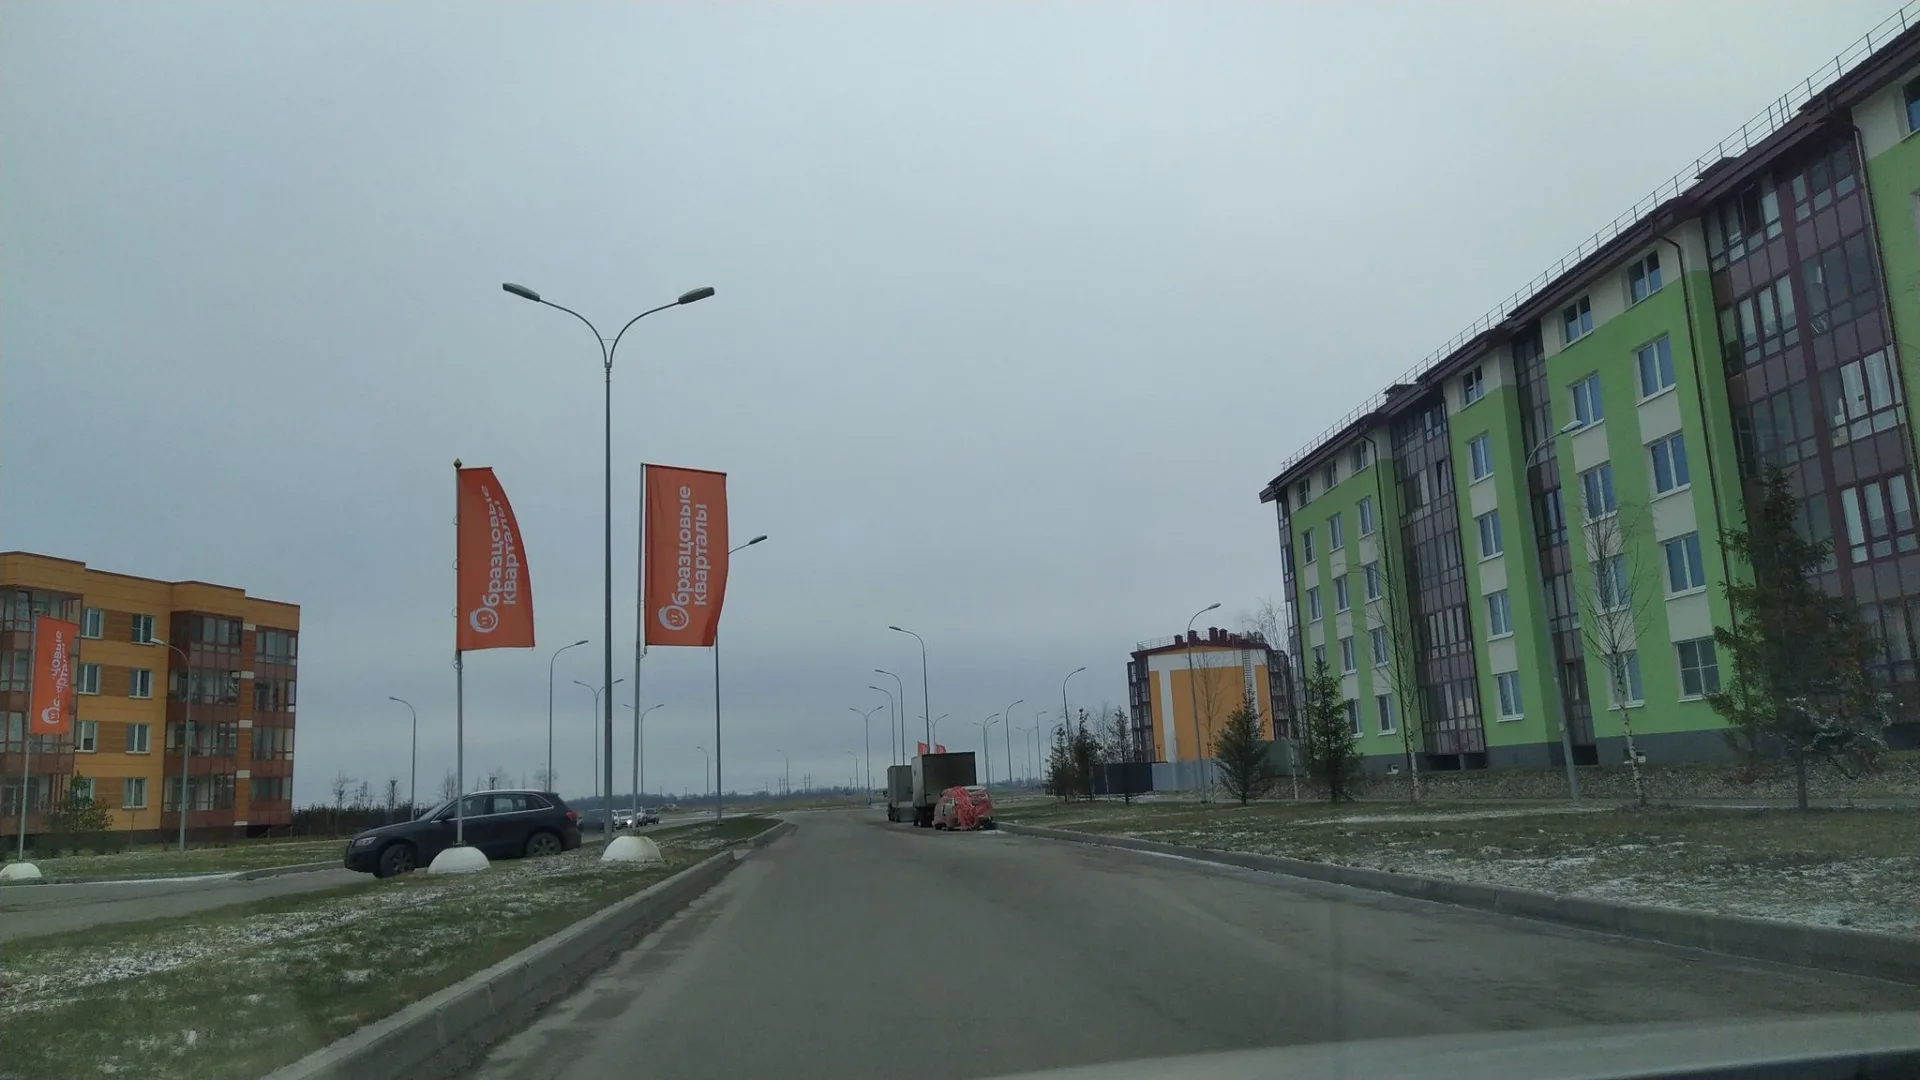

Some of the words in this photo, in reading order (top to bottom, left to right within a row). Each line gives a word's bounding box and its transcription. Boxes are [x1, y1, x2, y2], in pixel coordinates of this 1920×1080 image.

[469, 485, 504, 633] Образцовые
[494, 500, 520, 605] кварталы
[658, 485, 694, 631] Образцовые
[694, 503, 711, 606] кварталы
